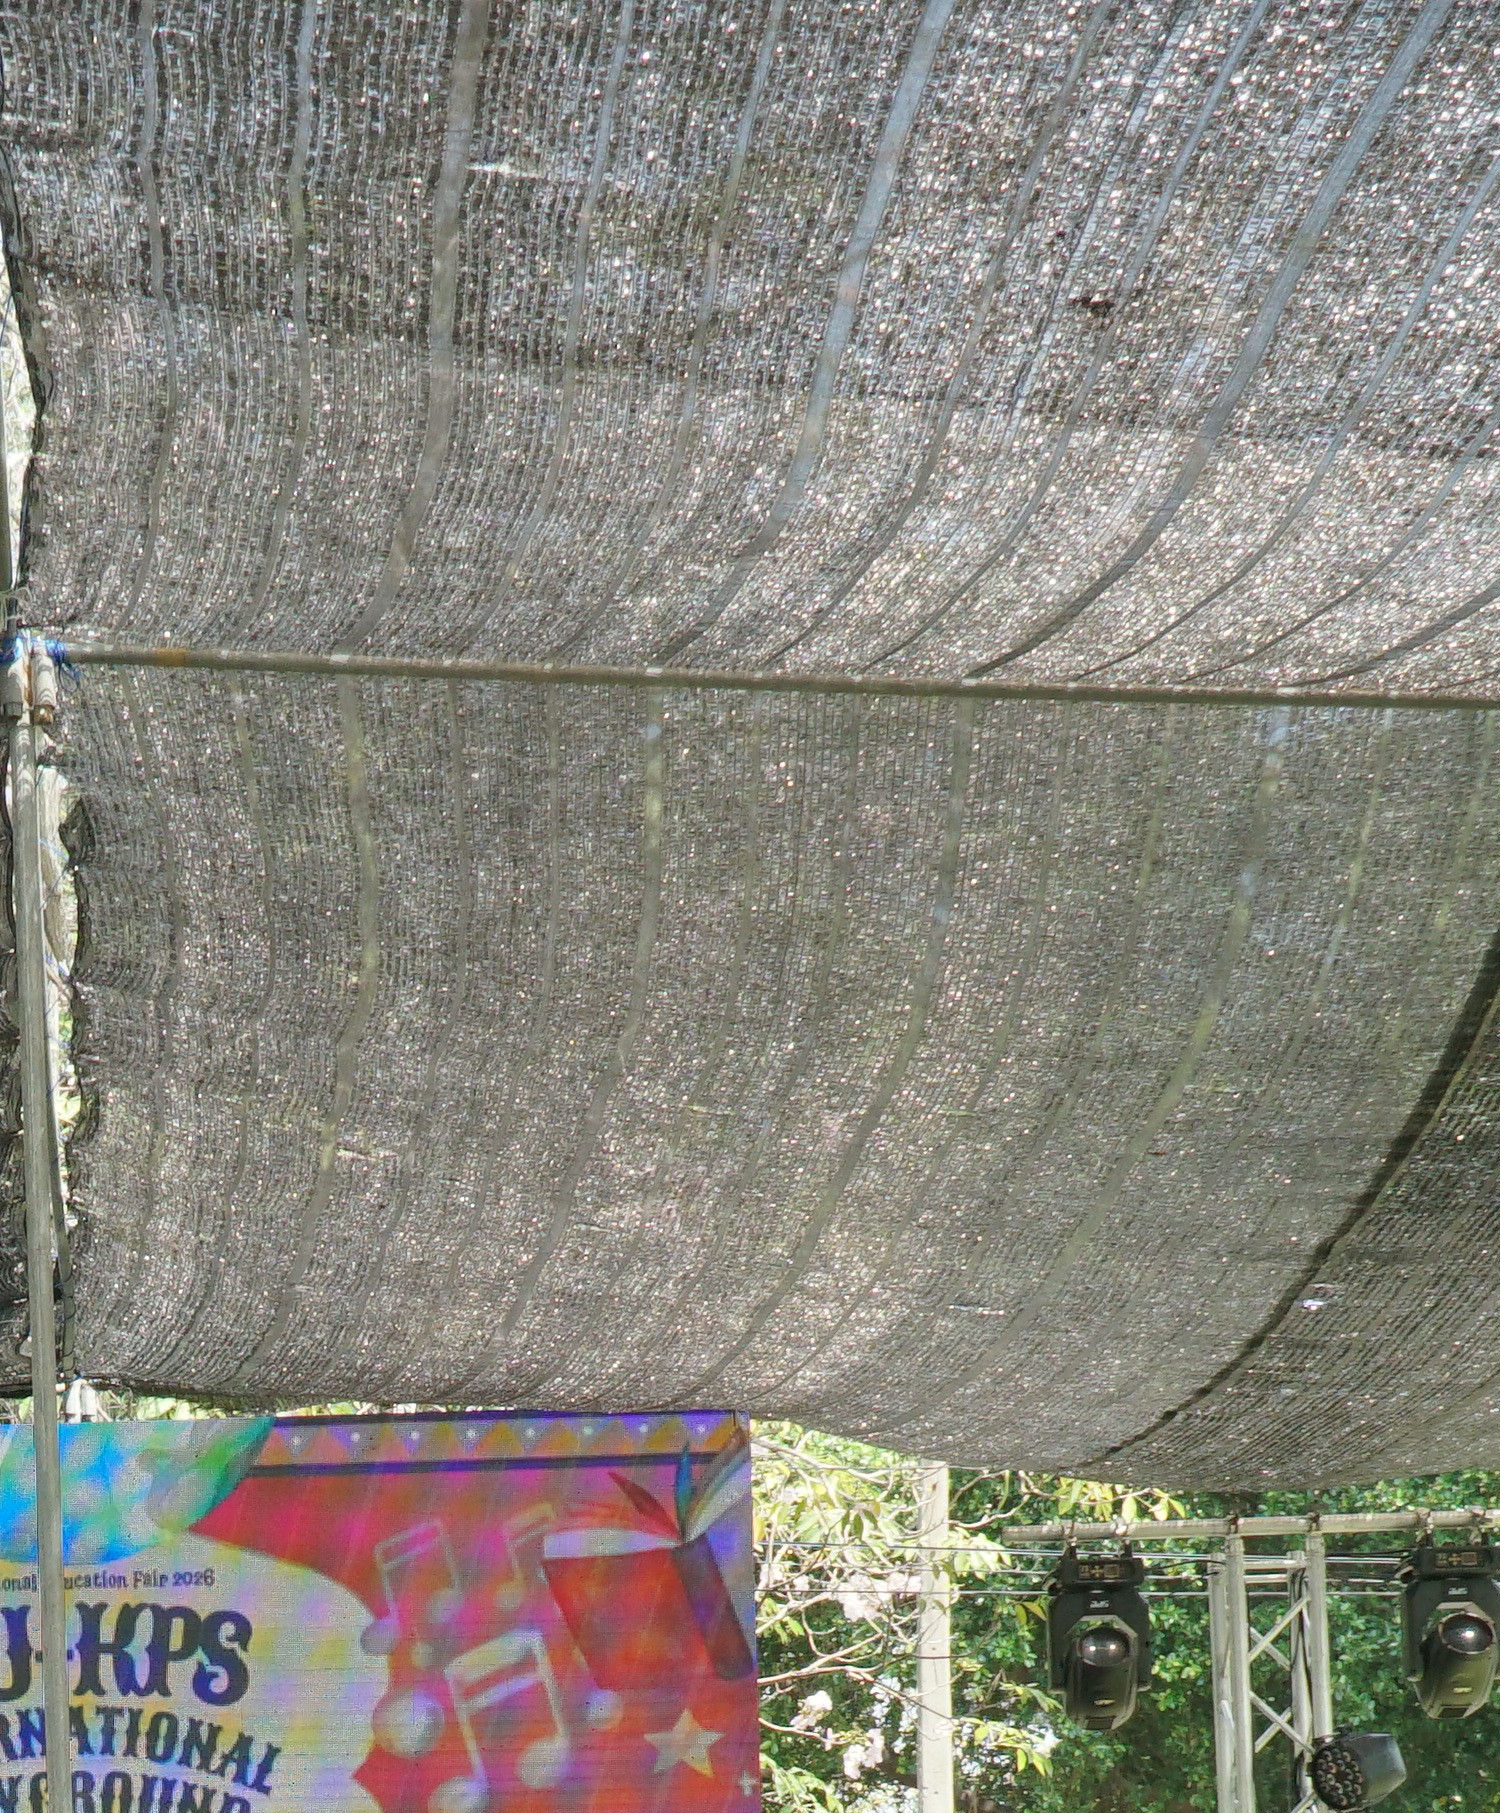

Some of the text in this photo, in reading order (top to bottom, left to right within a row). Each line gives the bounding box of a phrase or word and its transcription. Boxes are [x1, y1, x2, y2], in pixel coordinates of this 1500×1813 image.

[64, 1571, 127, 1590] ucation
[133, 1571, 168, 1590] Fair
[173, 1567, 215, 1588] 2026
